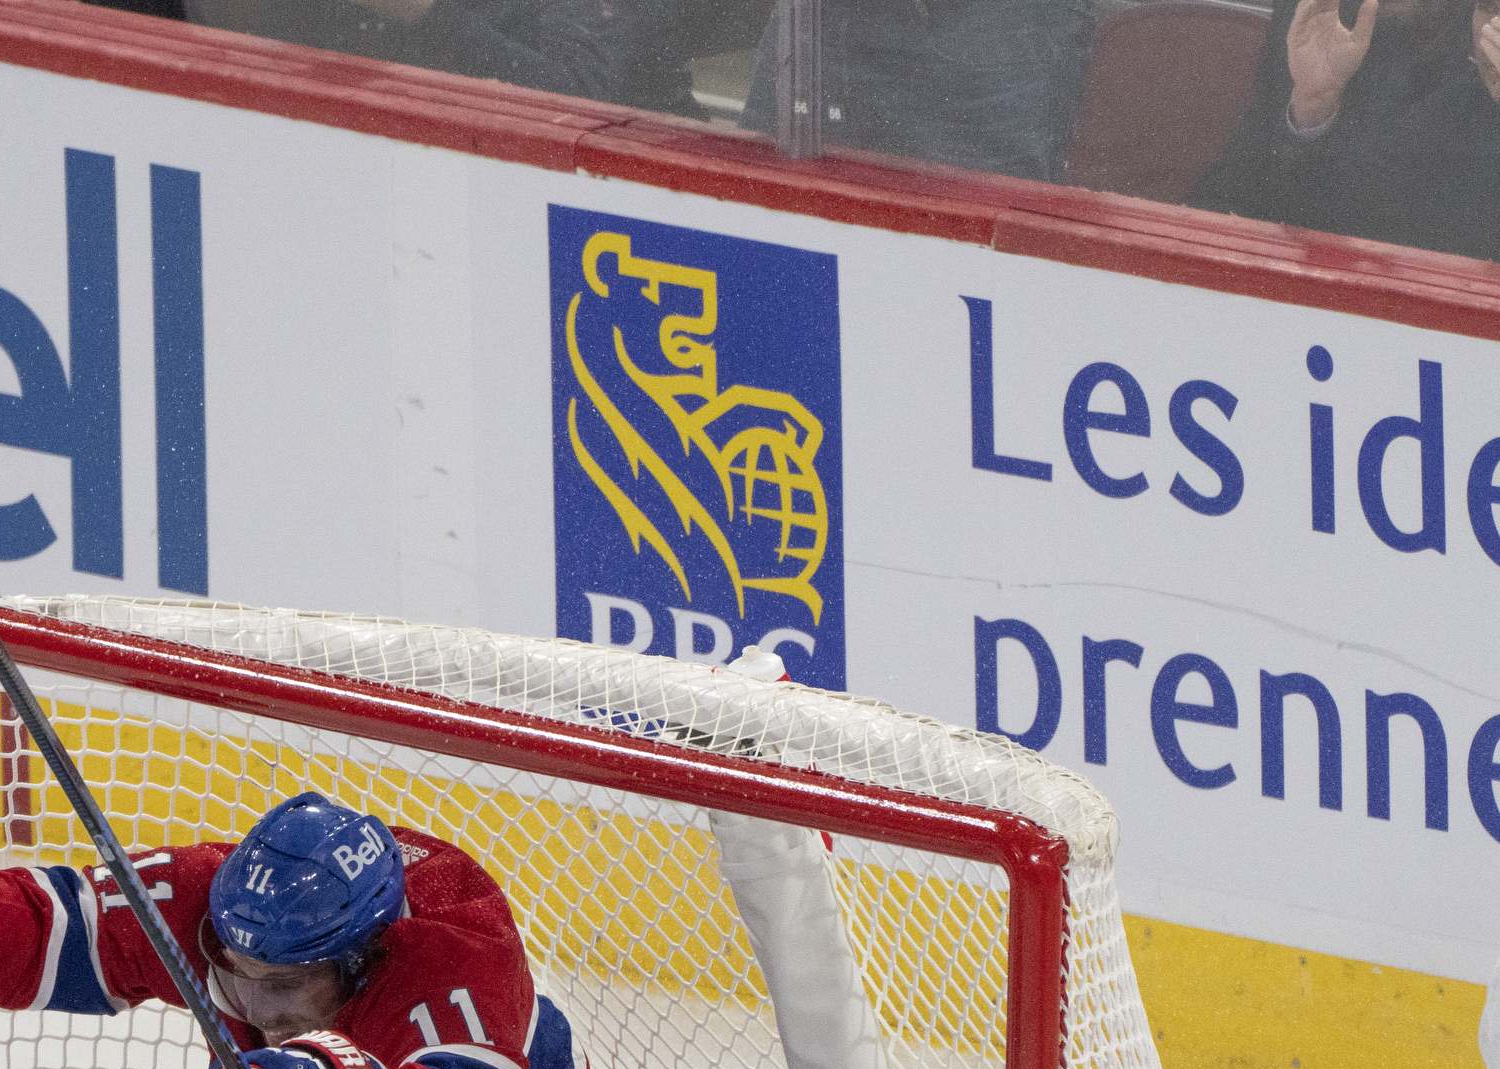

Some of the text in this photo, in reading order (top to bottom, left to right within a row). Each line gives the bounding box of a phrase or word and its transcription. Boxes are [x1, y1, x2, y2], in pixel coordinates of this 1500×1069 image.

[958, 294, 1244, 517] Les
[246, 864, 273, 894] 11
[331, 822, 385, 881] Bell
[409, 987, 496, 1047] 11
